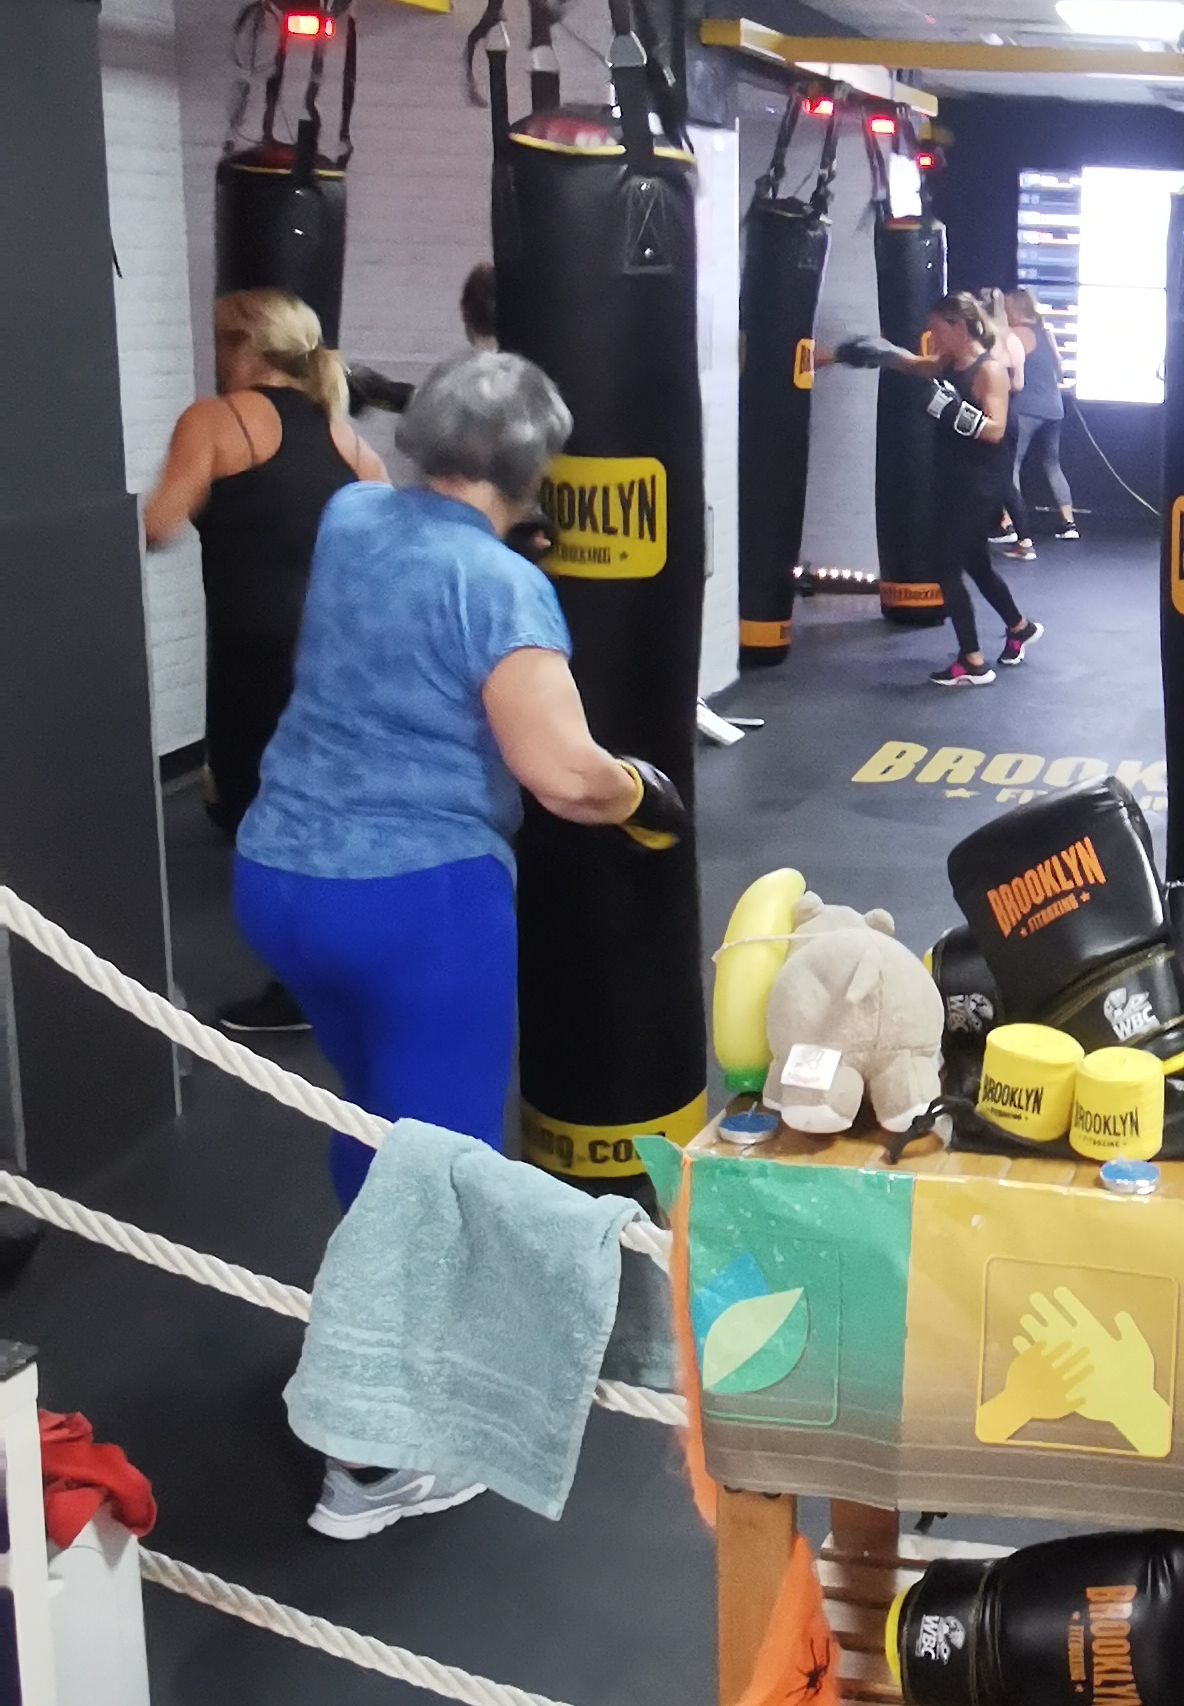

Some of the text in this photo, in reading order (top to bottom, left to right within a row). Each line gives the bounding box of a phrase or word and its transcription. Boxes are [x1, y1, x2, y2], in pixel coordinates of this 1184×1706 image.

[538, 474, 657, 542] OOKLYN
[852, 741, 1167, 792] BROOK
[987, 835, 1106, 938] BROOKLYN
[1113, 1004, 1157, 1042] WBC
[982, 1073, 1044, 1115] BROOKLYN
[1074, 1099, 1139, 1137] BROOKLYN
